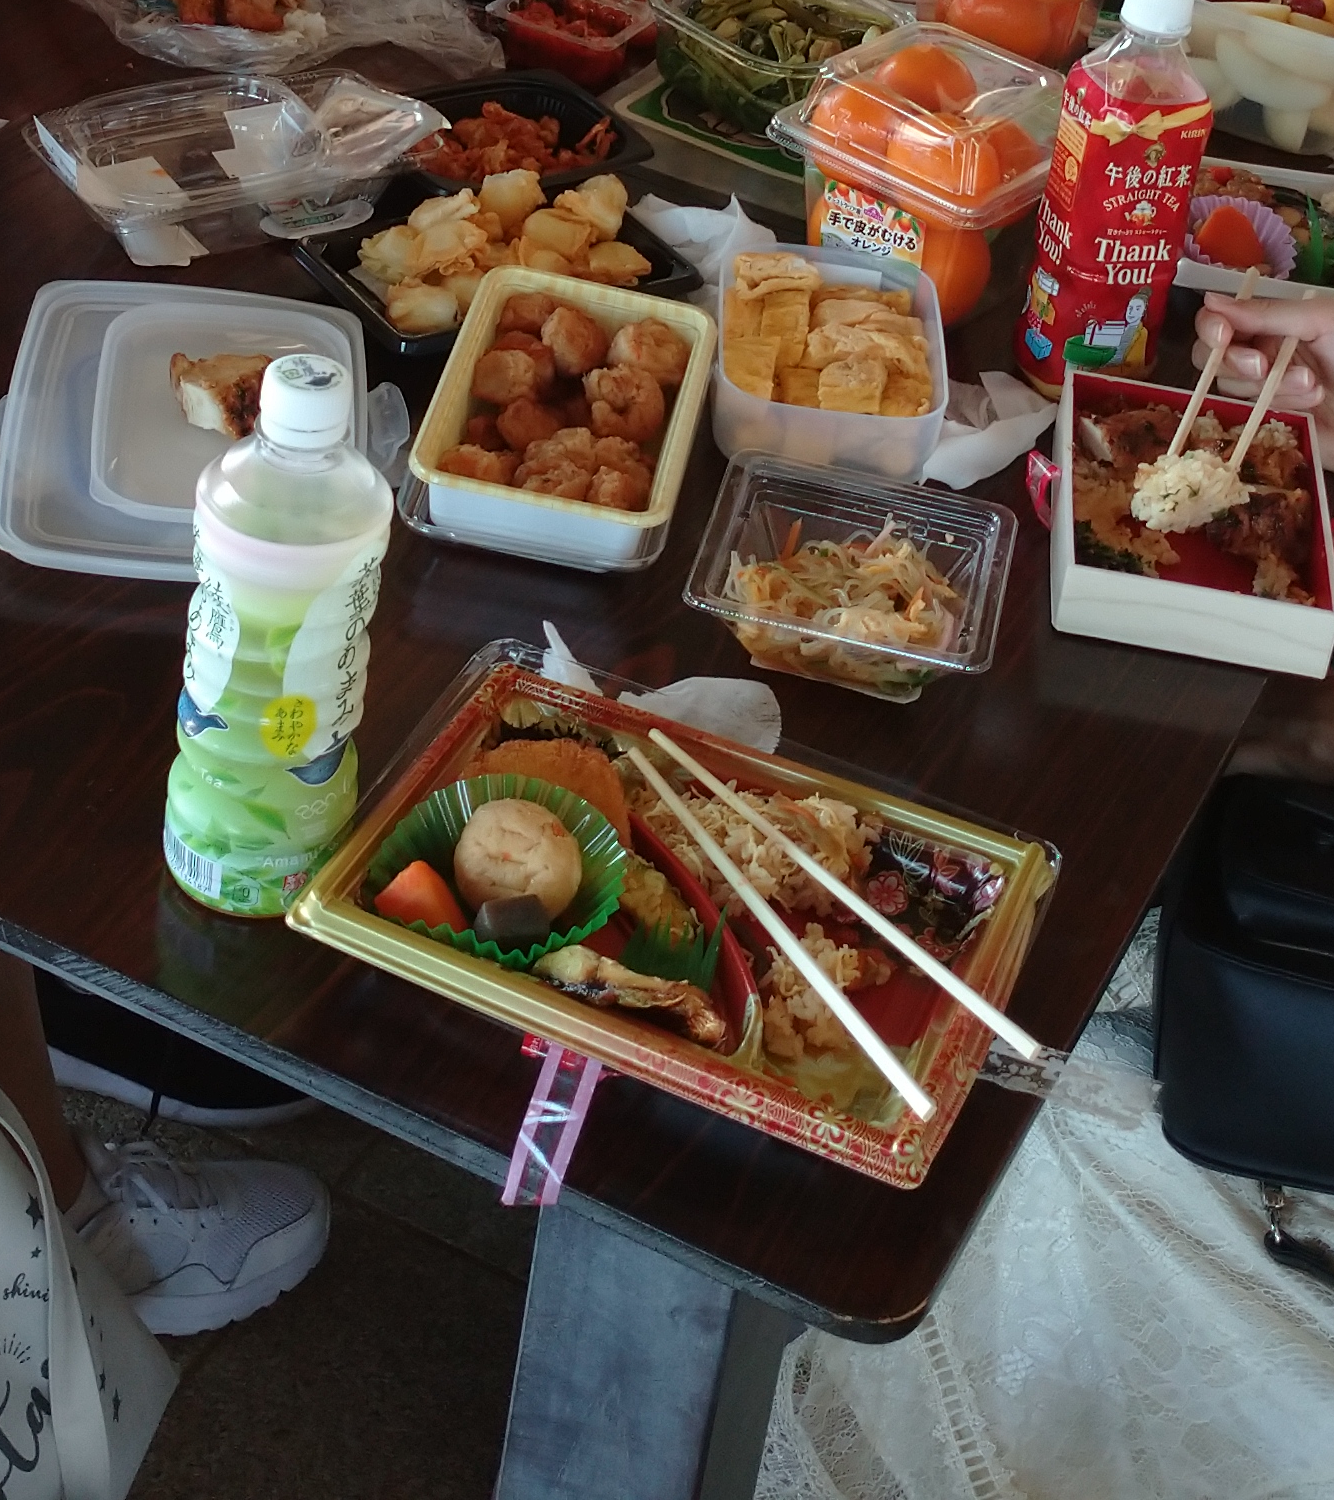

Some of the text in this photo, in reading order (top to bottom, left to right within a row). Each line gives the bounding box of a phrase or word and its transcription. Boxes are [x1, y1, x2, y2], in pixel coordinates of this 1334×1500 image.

[1105, 162, 1192, 189] 午後の紅茶
[1103, 189, 1180, 212] STRAIGHT TEA
[828, 210, 916, 251] 手で皮がむける
[1038, 195, 1074, 250] Thank
[851, 237, 891, 256] オレンジ
[1038, 220, 1063, 266] You!
[1095, 238, 1172, 262] Thank
[1105, 263, 1156, 285] You!
[201, 769, 222, 788] Tea
